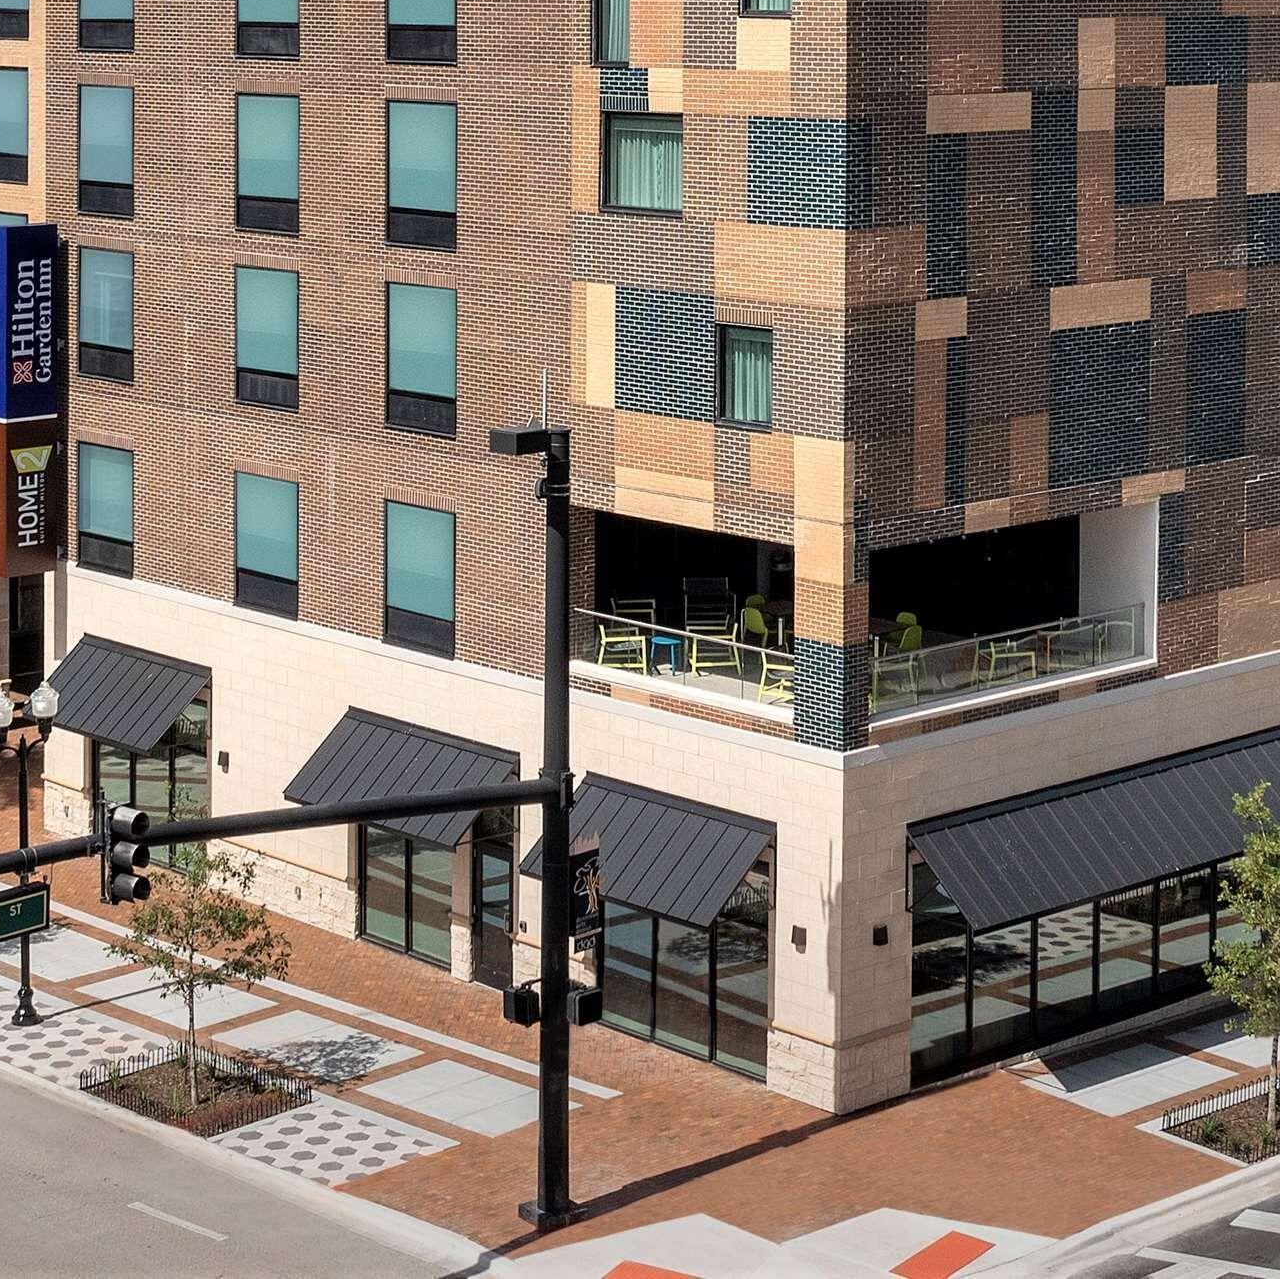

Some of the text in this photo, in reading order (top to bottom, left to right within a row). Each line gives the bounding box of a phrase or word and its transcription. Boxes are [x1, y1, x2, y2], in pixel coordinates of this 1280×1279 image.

[11, 259, 35, 358] Hilton
[35, 258, 52, 383] Garden Inn
[16, 448, 48, 547] HOME 2
[9, 903, 23, 918] ST
